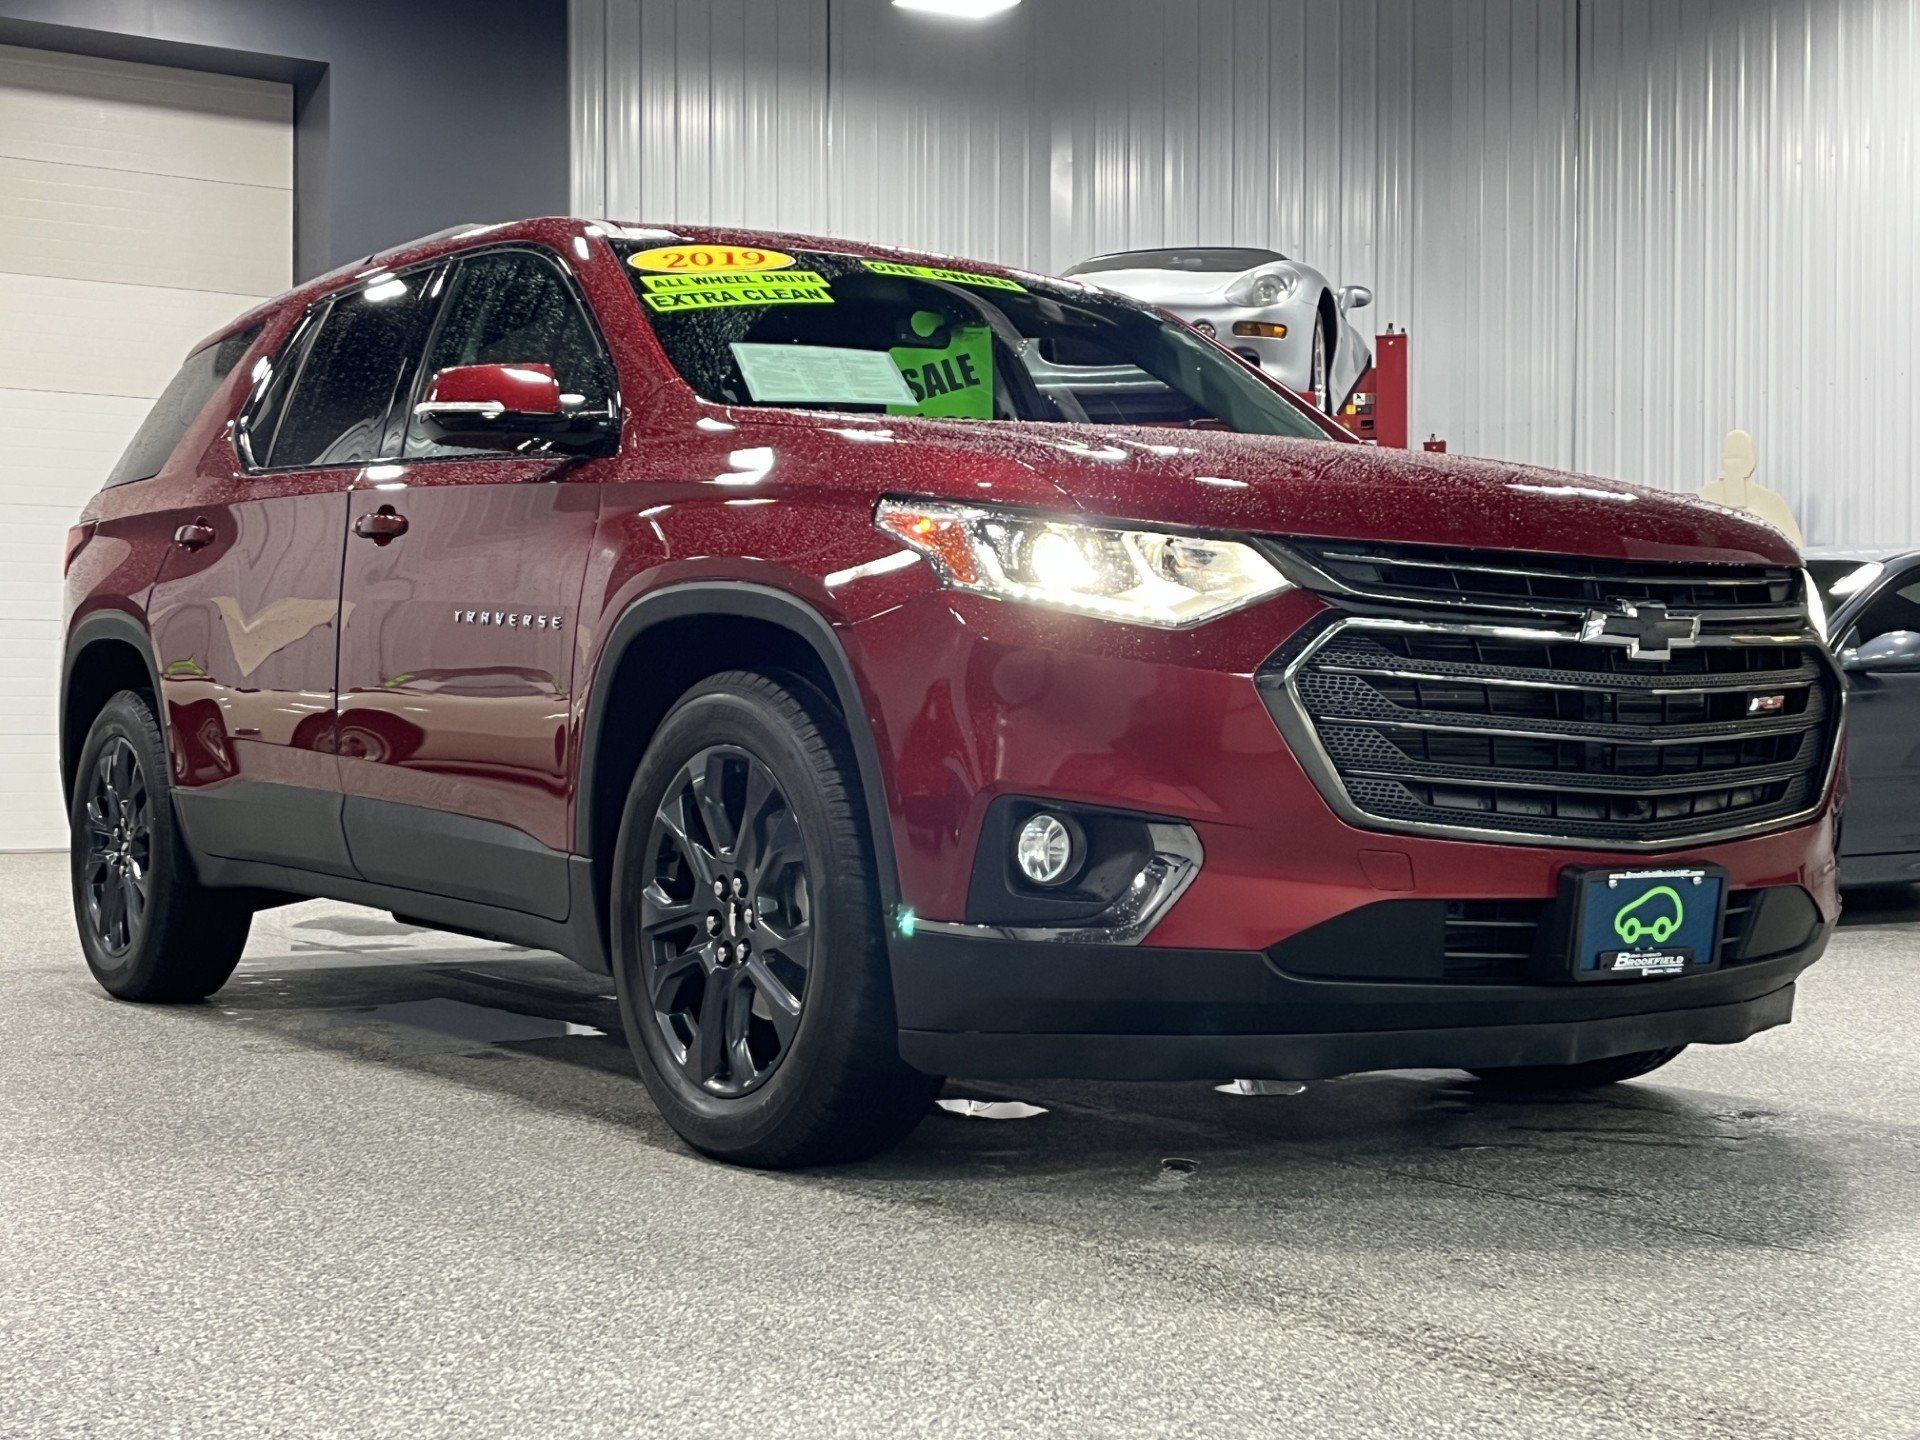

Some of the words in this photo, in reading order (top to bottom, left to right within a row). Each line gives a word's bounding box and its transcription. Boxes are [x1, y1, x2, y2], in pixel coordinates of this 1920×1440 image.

[662, 251, 766, 268] 2019
[653, 279, 689, 288] ALL
[691, 275, 757, 285] WHEEL
[761, 274, 819, 284] DRIVE
[870, 263, 919, 275] ONE
[931, 270, 1014, 288] OWNER
[653, 291, 740, 307] EXTRA
[742, 288, 824, 300] CLEAN
[901, 353, 981, 403] SALE
[454, 610, 562, 629] TRAVERSE
